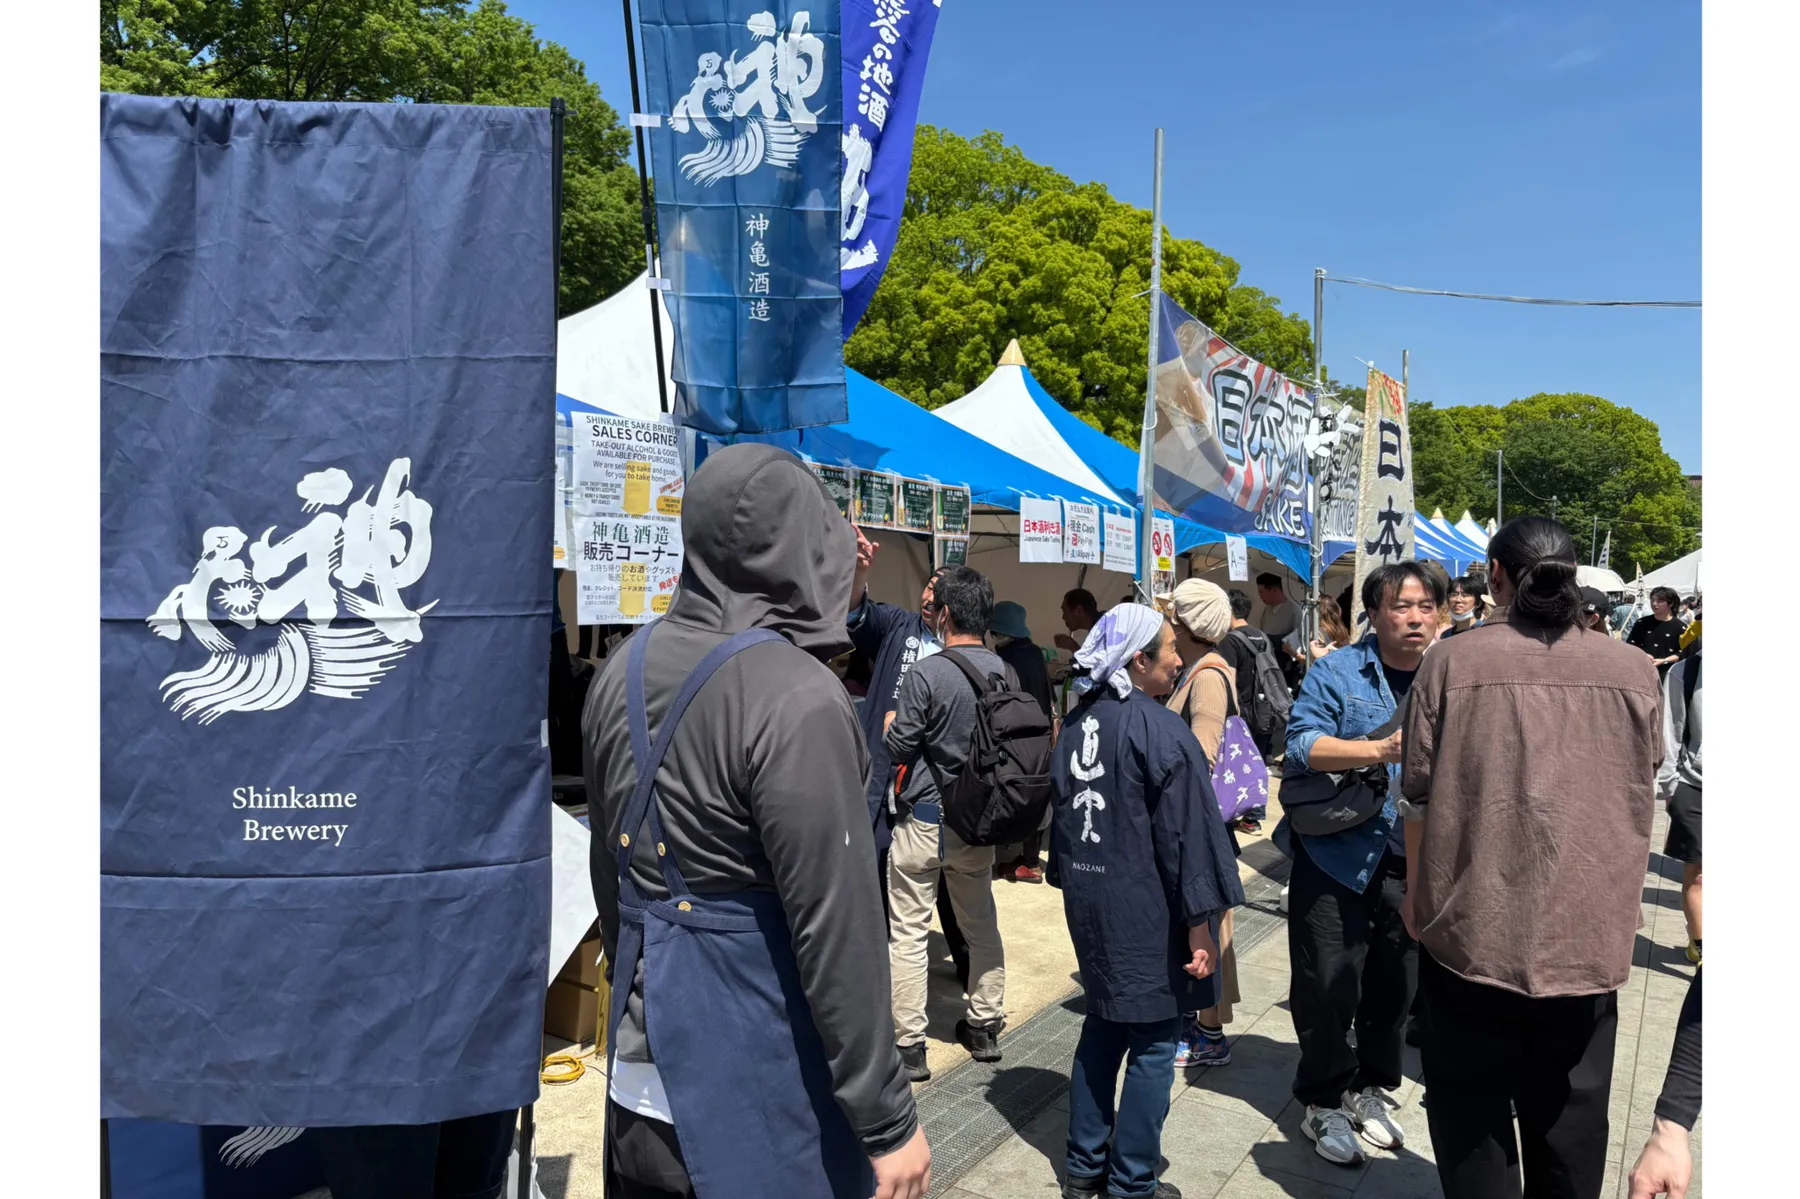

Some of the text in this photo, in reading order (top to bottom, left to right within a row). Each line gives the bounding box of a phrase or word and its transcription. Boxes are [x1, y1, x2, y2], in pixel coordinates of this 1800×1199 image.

[745, 212, 771, 322] 神亀酒造
[586, 416, 680, 436] SHINKAME SAKE BREWERY
[592, 424, 678, 447] SALES CORNER
[592, 440, 625, 450] TAKE-OUT
[627, 444, 656, 454] ALCOHOL
[662, 450, 678, 458] GOODS
[597, 450, 676, 465] AVAILABLE FOR PURCHASE
[614, 462, 635, 472] selling
[1254, 489, 1305, 540] SAKE
[592, 521, 669, 545] 神亀酒造
[1082, 523, 1095, 533] Cash
[584, 542, 679, 562] 販売コーナー
[232, 786, 358, 809] Shinkame
[243, 818, 349, 847] Brewery
